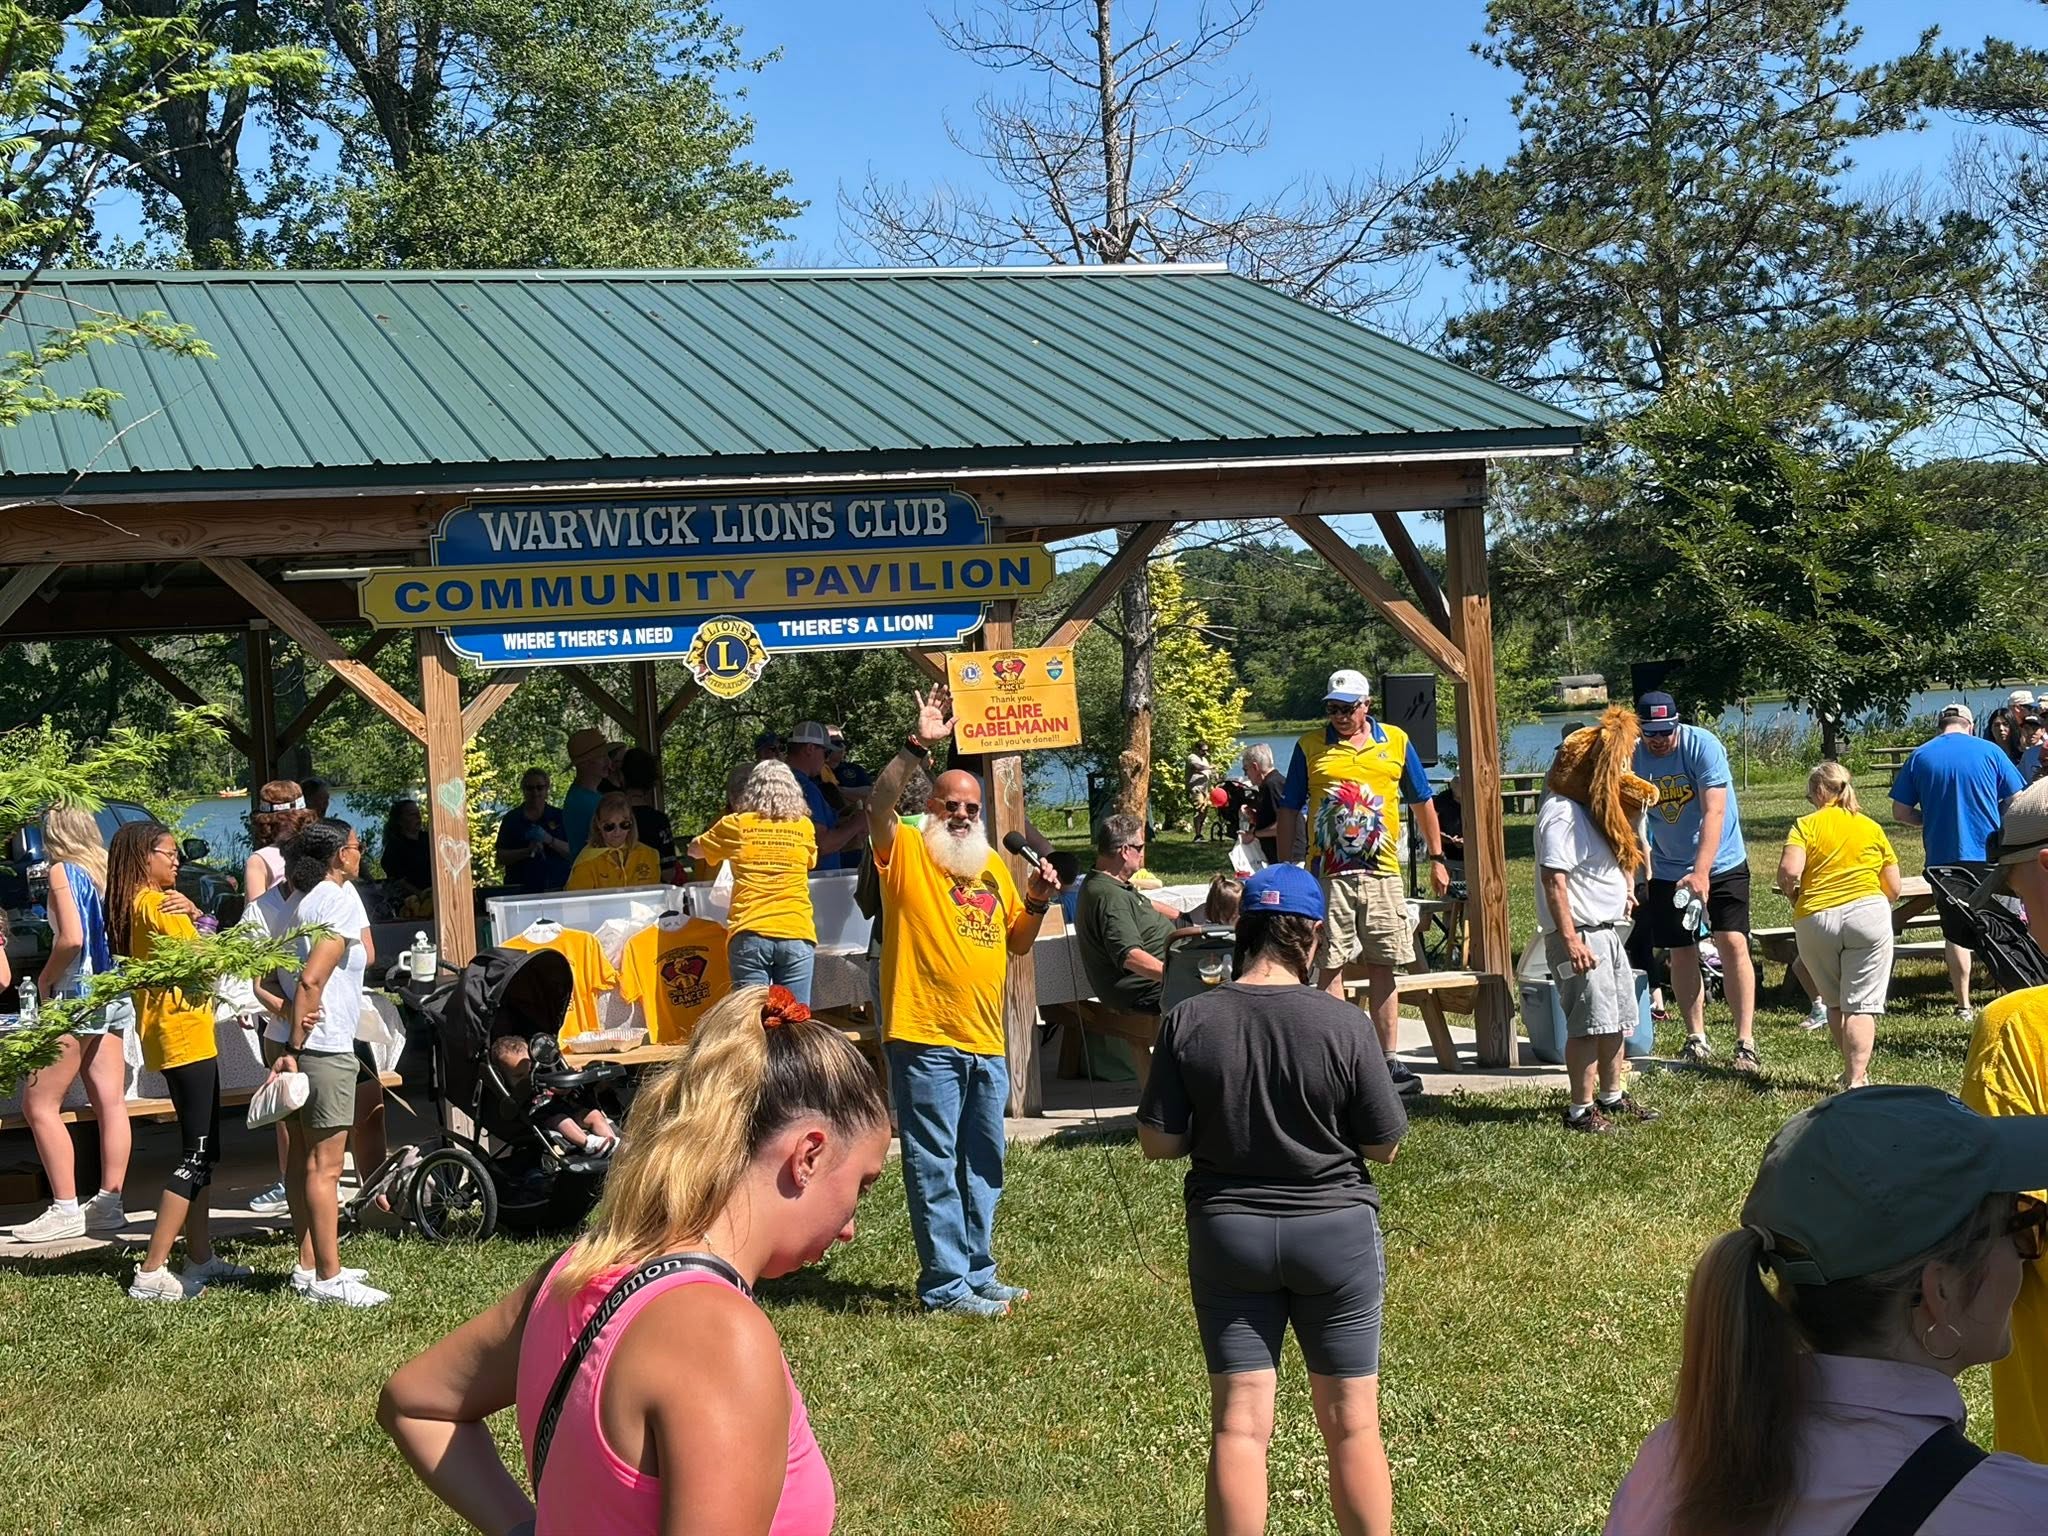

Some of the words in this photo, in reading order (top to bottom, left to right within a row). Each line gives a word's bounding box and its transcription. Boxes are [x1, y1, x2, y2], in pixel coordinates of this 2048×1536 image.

[478, 506, 700, 551] WARWICK
[711, 500, 836, 543] LIONS
[847, 497, 949, 538] CLUB
[394, 569, 756, 614] COMMUNITY
[785, 557, 1031, 597] PAVILION
[706, 620, 750, 637] LIONS
[778, 618, 860, 637] THERE'S
[864, 617, 879, 633] A
[883, 614, 934, 633] LION!
[502, 632, 556, 651] WHERE
[558, 629, 618, 648] THERE'S
[622, 629, 632, 645] A
[635, 627, 673, 644] NEED
[716, 641, 739, 670] L
[968, 668, 976, 678] L
[985, 703, 1043, 721] CLAIRE
[963, 717, 1069, 739] GABELMANN
[994, 738, 1004, 746] all
[1006, 737, 1031, 747] you've
[1034, 735, 1060, 743] done!!!
[957, 925, 1001, 941] CANCER
[672, 989, 710, 1005] CANCER
[578, 1258, 682, 1357] lululemon
